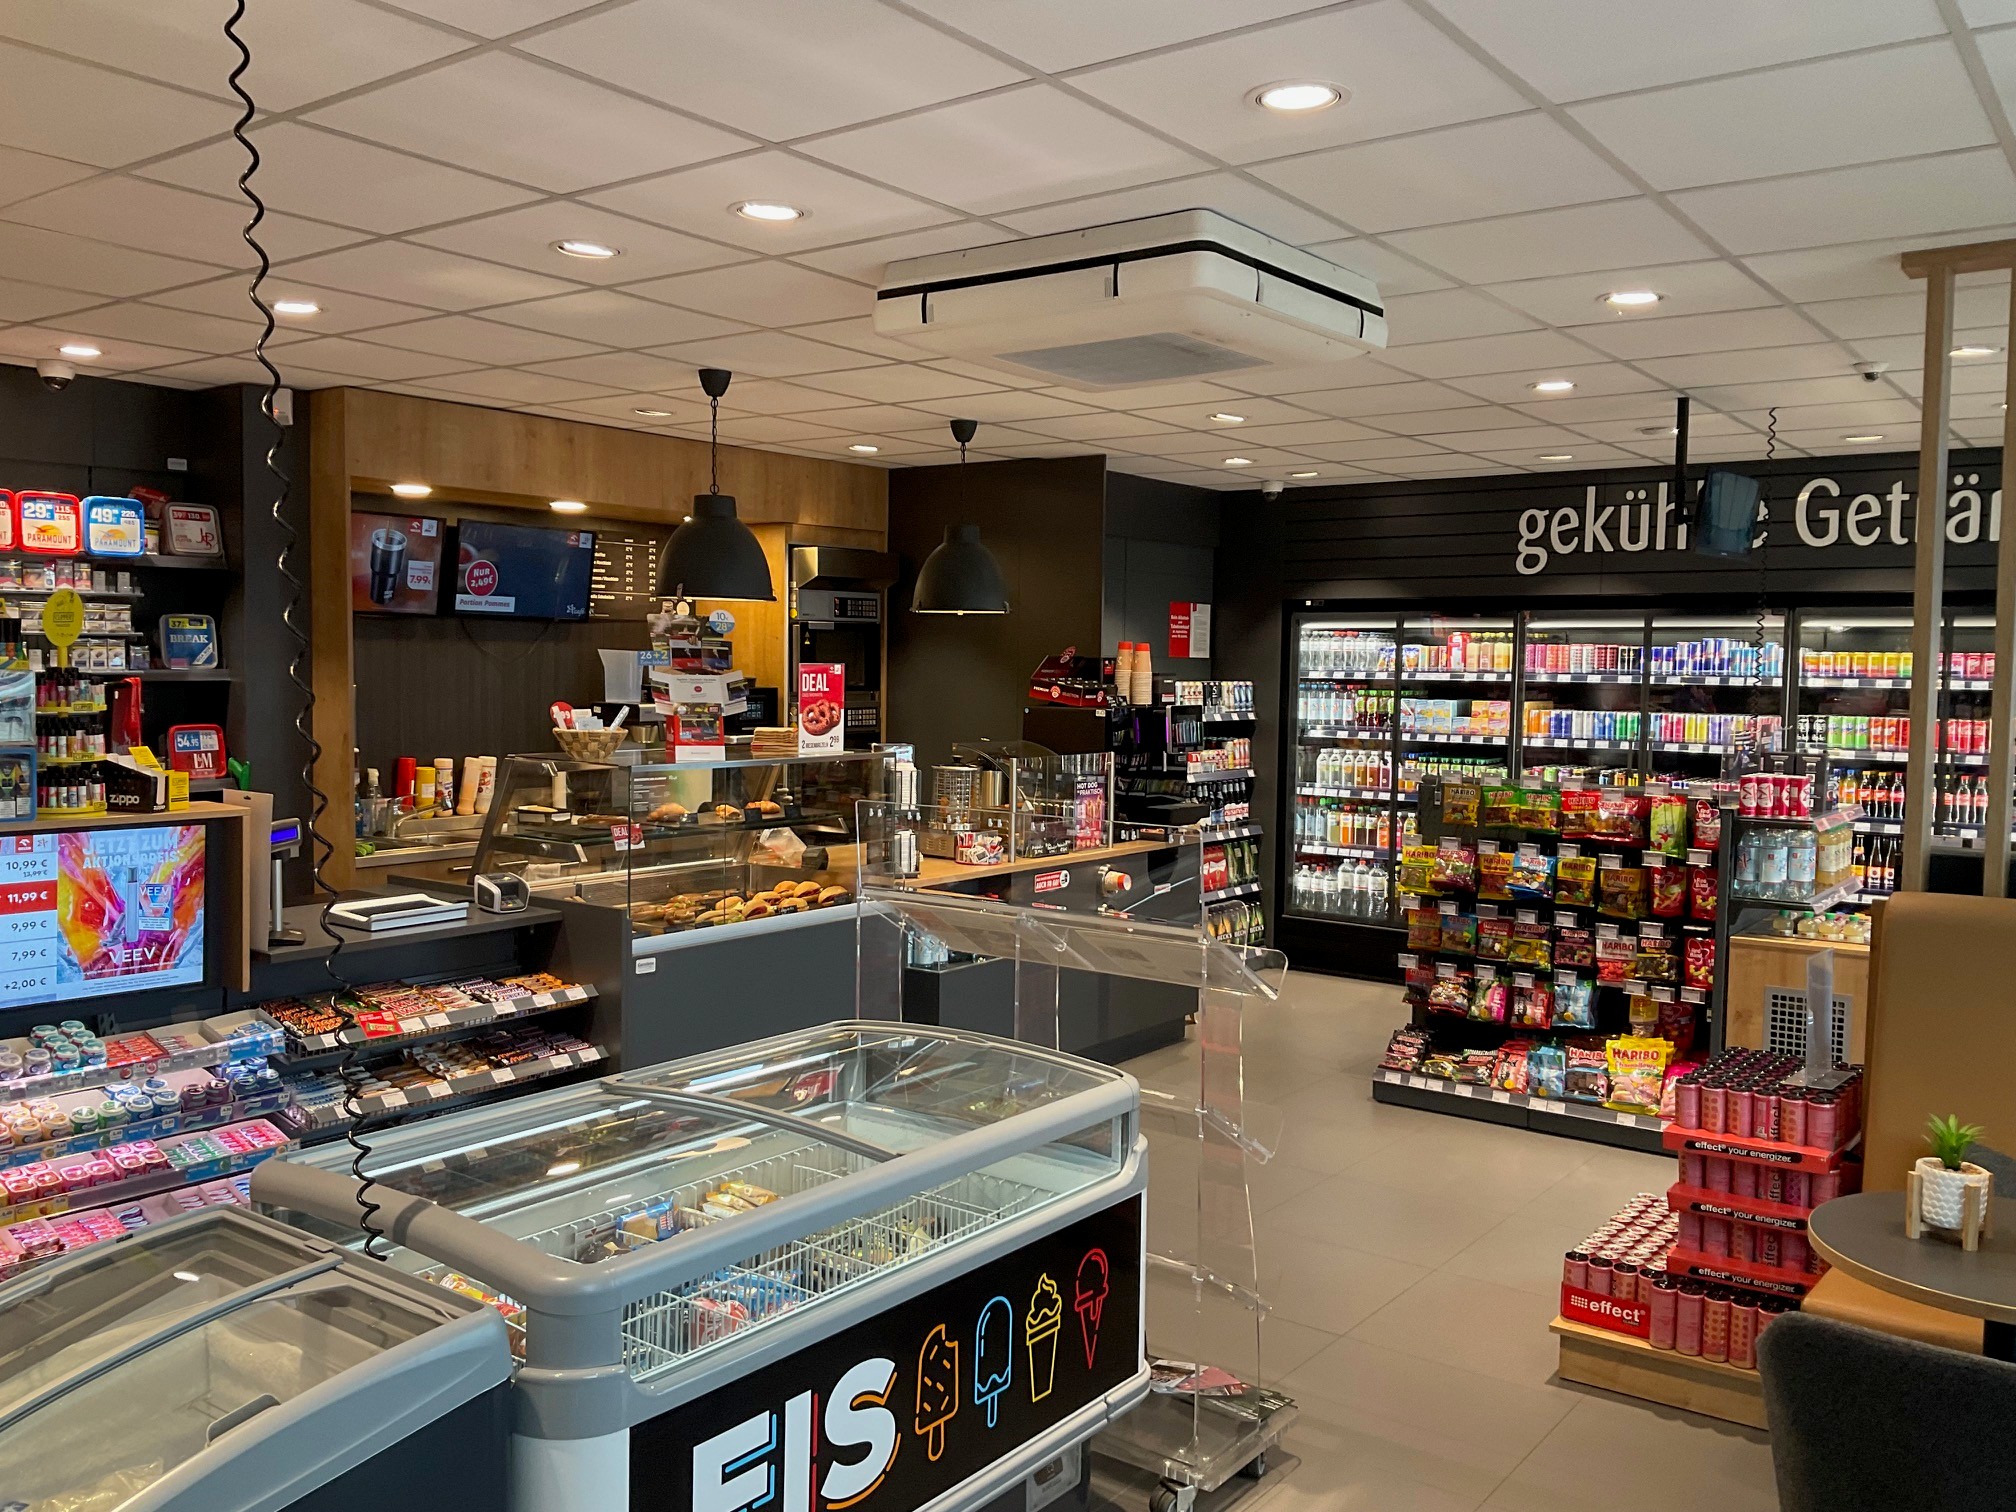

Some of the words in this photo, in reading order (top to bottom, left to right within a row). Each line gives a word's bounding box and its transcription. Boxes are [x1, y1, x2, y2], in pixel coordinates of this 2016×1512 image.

[27, 533, 72, 544] PARAMOUNT
[94, 539, 136, 548] PARAMOUNT
[473, 568, 490, 577] NUR
[170, 634, 208, 643] BREAK
[802, 673, 829, 692] DEAL
[1451, 788, 1475, 796] HARIBO
[109, 794, 140, 806] zippo
[614, 827, 628, 836] DEAL
[1406, 850, 1435, 859] HARIBO
[6, 860, 37, 871] 10,99
[1483, 856, 1511, 866] HARIBO
[1562, 863, 1592, 872] HARIBO
[1604, 873, 1634, 883] HARIBO
[139, 886, 169, 896] VEEV
[7, 891, 37, 903] 11,99
[40, 891, 47, 899] €
[11, 921, 36, 932] 9,99
[1515, 924, 1547, 933] HARIBO
[1561, 929, 1589, 938] HARIBO
[1602, 941, 1635, 951] HARIBO
[12, 950, 36, 961] 7,99
[109, 946, 156, 963] VEEV
[4, 979, 36, 990] +2,00
[1612, 1048, 1661, 1061] HARIBO
[1728, 1146, 1748, 1157] your
[1733, 1210, 1753, 1220] your
[1732, 1274, 1752, 1283] your
[693, 1357, 897, 1511] EIS
